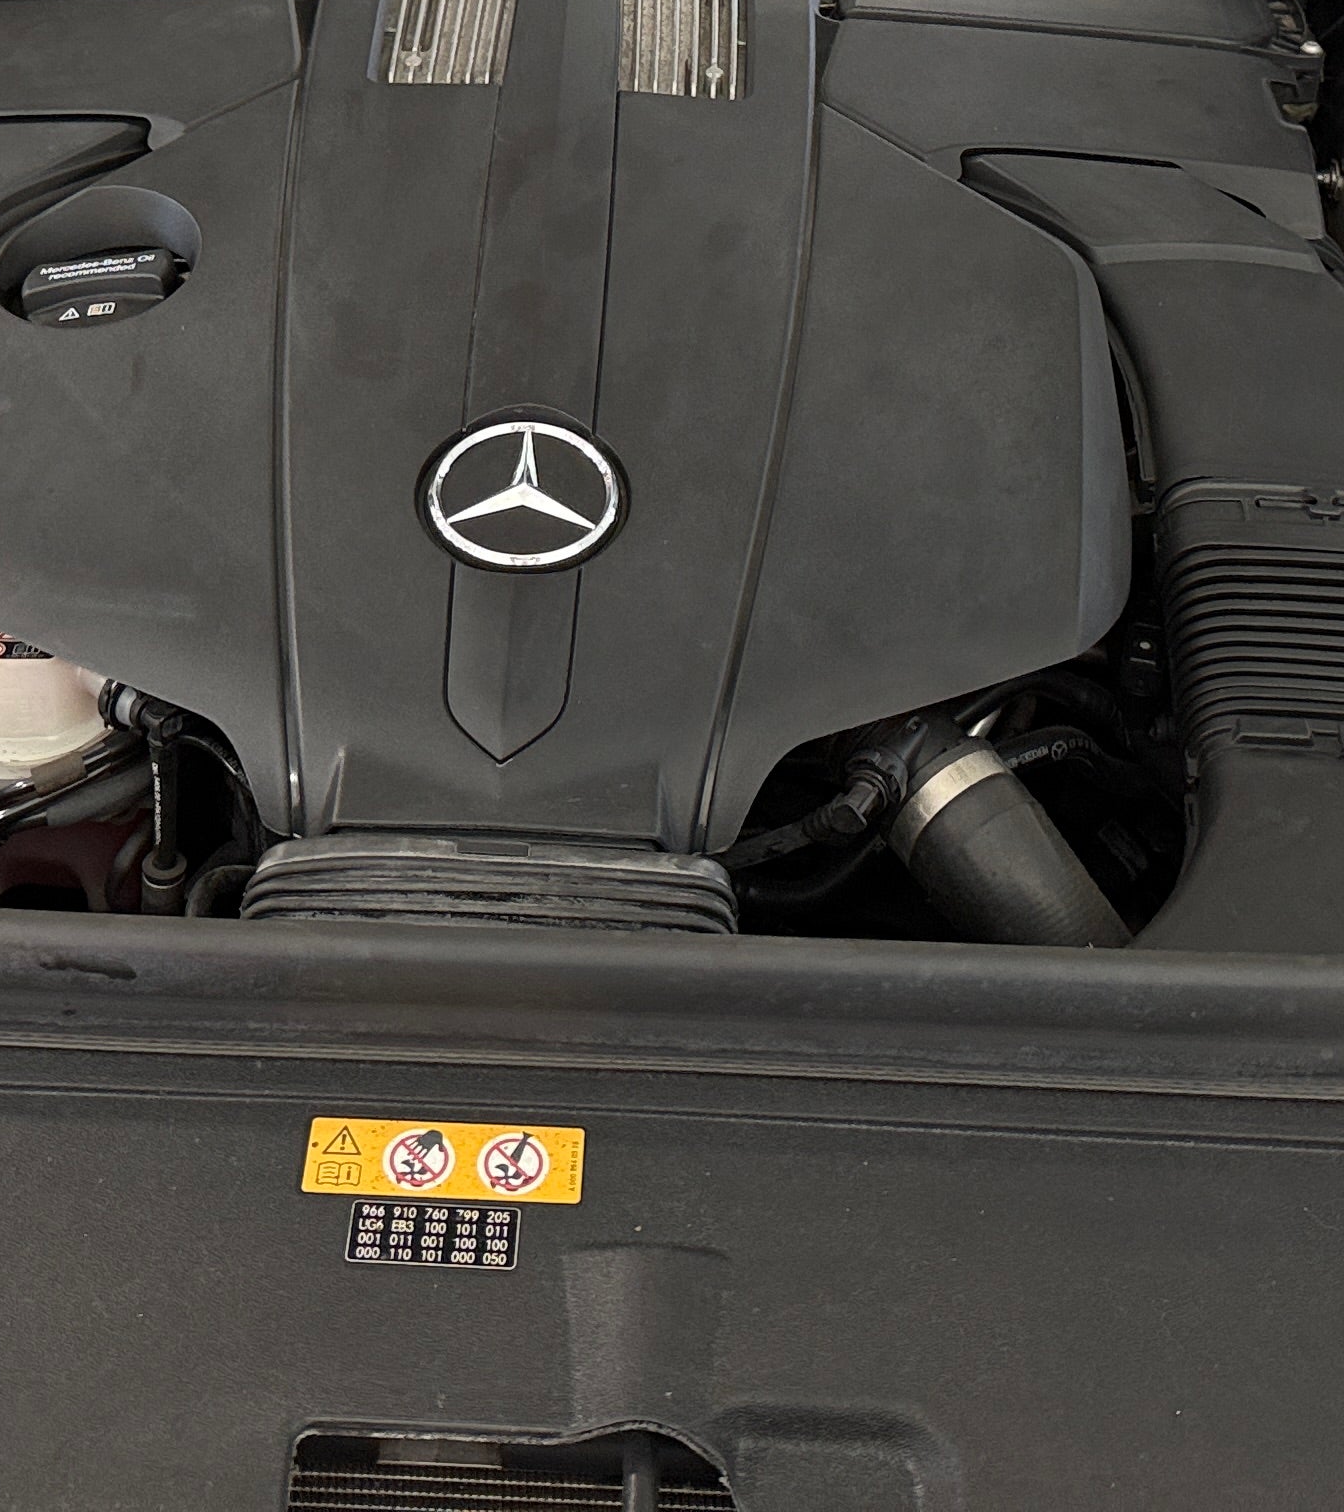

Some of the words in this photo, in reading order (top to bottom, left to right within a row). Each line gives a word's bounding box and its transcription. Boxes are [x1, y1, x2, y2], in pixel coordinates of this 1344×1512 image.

[39, 257, 135, 276] Mercedes-Benz
[137, 254, 156, 263] Oil
[48, 263, 136, 281] recommended
[362, 1205, 385, 1217] 966
[394, 1207, 417, 1218] 910
[425, 1208, 448, 1220] 760
[456, 1210, 479, 1221] 799
[487, 1211, 510, 1223] 205
[425, 1222, 447, 1234] 100
[456, 1224, 477, 1235] 101
[486, 1225, 508, 1237] 011
[358, 1232, 380, 1245] 001
[389, 1234, 412, 1246] 011
[421, 1236, 443, 1248] 001
[454, 1238, 477, 1249] 100
[487, 1239, 508, 1251] 100
[356, 1247, 380, 1258] 000
[390, 1248, 412, 1260] 110
[422, 1250, 442, 1262] 101
[451, 1251, 475, 1263] 000
[483, 1253, 507, 1265] 050
